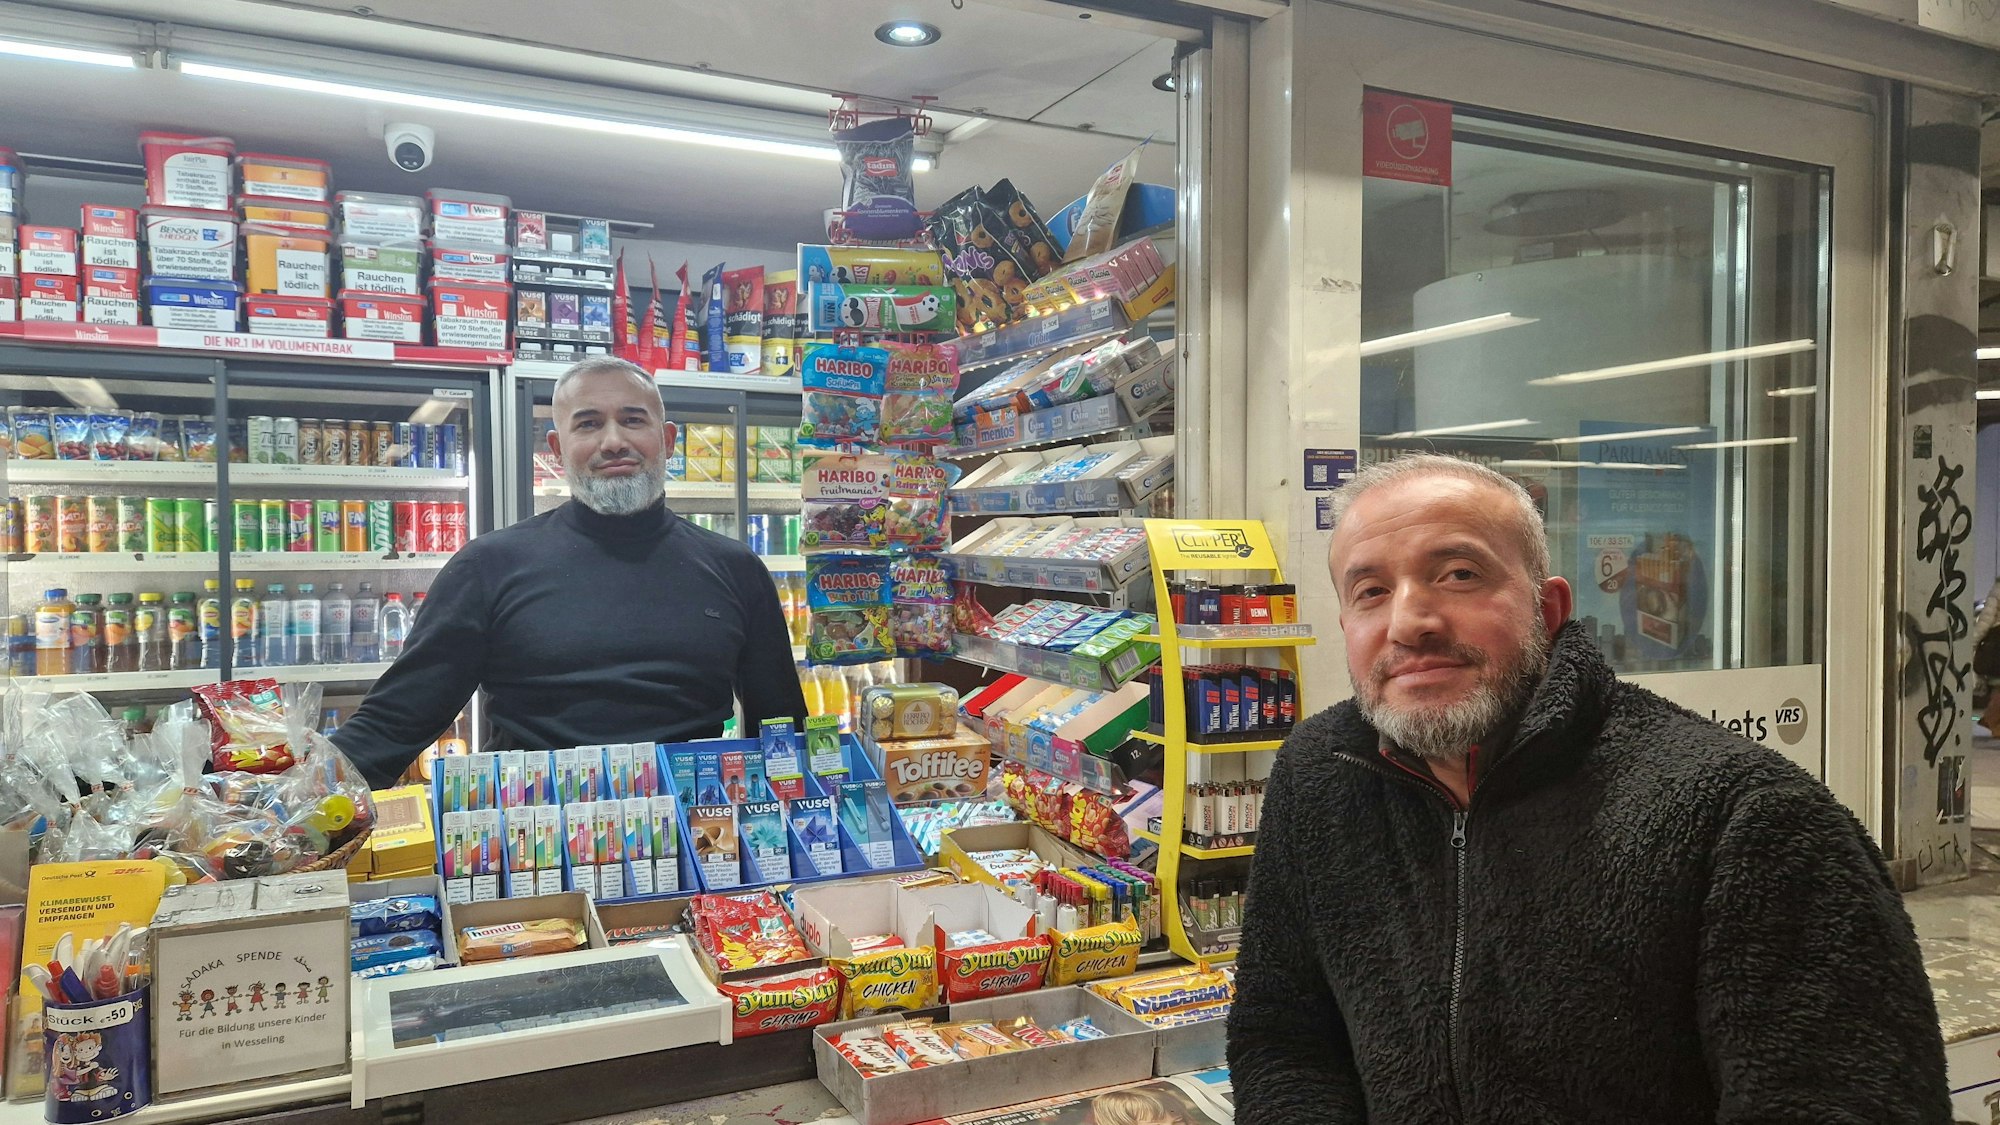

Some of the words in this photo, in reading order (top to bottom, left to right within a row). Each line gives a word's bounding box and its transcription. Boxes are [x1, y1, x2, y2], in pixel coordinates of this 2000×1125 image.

[473, 206, 500, 215] West
[160, 225, 199, 235] BENSON
[86, 236, 135, 248] Rauchen
[29, 250, 66, 258] Rauchen
[103, 247, 117, 256] ist
[154, 247, 200, 255] Tabakrauch
[202, 250, 229, 258] enthält
[92, 256, 129, 266] tödlich
[187, 257, 213, 265] Stoffe,
[472, 254, 493, 263] West
[34, 265, 63, 273] tödlich
[278, 260, 324, 272] Rauchen
[295, 271, 309, 281] ist
[357, 271, 404, 284] Rauchen
[1089, 269, 1110, 279] Ricola
[284, 281, 320, 292] tödlich
[1067, 275, 1087, 286] Ricola
[355, 283, 371, 294] ist
[373, 283, 406, 294] tödlich
[30, 300, 67, 308] Rauchen
[87, 297, 135, 308] Rauchen
[103, 308, 117, 317] ist
[463, 304, 498, 319] Winston
[727, 310, 762, 323] schädigt
[92, 316, 129, 325] tödlich
[75, 329, 109, 340] Winston
[203, 336, 222, 347] DIE
[225, 337, 248, 348] NR.1
[252, 339, 265, 349] IM
[268, 340, 353, 354] VOLUMENTABAK
[816, 357, 873, 378] HARIBO
[890, 358, 950, 375] HARIBO
[1133, 379, 1158, 397] extra
[980, 425, 1015, 442] mentos
[1599, 442, 1695, 464] PARLIAMENT
[818, 470, 876, 483] HARIBO
[1608, 536, 1617, 545] 33
[1618, 536, 1632, 545] STK
[1601, 555, 1613, 577] 6
[1607, 580, 1618, 590] 20
[1250, 608, 1268, 618] DENIM
[1775, 707, 1800, 724] VRS
[890, 750, 984, 785] Toffifee
[971, 852, 1004, 861] bueno
[113, 867, 146, 875] DHL
[989, 862, 1024, 870] bueno
[40, 895, 112, 907] KLIMABEWUSST
[39, 904, 93, 915] VERSENDEN
[95, 902, 115, 910] UND
[38, 912, 95, 923] EMPFANGEN
[472, 923, 523, 938] hanuta
[800, 914, 821, 947] duplo
[180, 958, 224, 990] SADAKA
[236, 951, 283, 963] SPENDE
[1076, 954, 1129, 976] CHICKEN
[979, 971, 1031, 991] SHRIMP
[862, 980, 918, 998] CHICKEN
[1132, 983, 1230, 1015] WUNDERBAR
[48, 1014, 94, 1026] Stück
[179, 1030, 196, 1039] Für
[198, 1026, 214, 1036] die
[217, 1020, 256, 1034] Bildung
[258, 1017, 292, 1029] unsere
[294, 1012, 327, 1025] Kinder
[758, 1010, 819, 1029] SHRIMP
[221, 1040, 231, 1050] in
[234, 1034, 285, 1049] Wesseling
[915, 1035, 950, 1056] bueno
[857, 1044, 895, 1064] bueno
